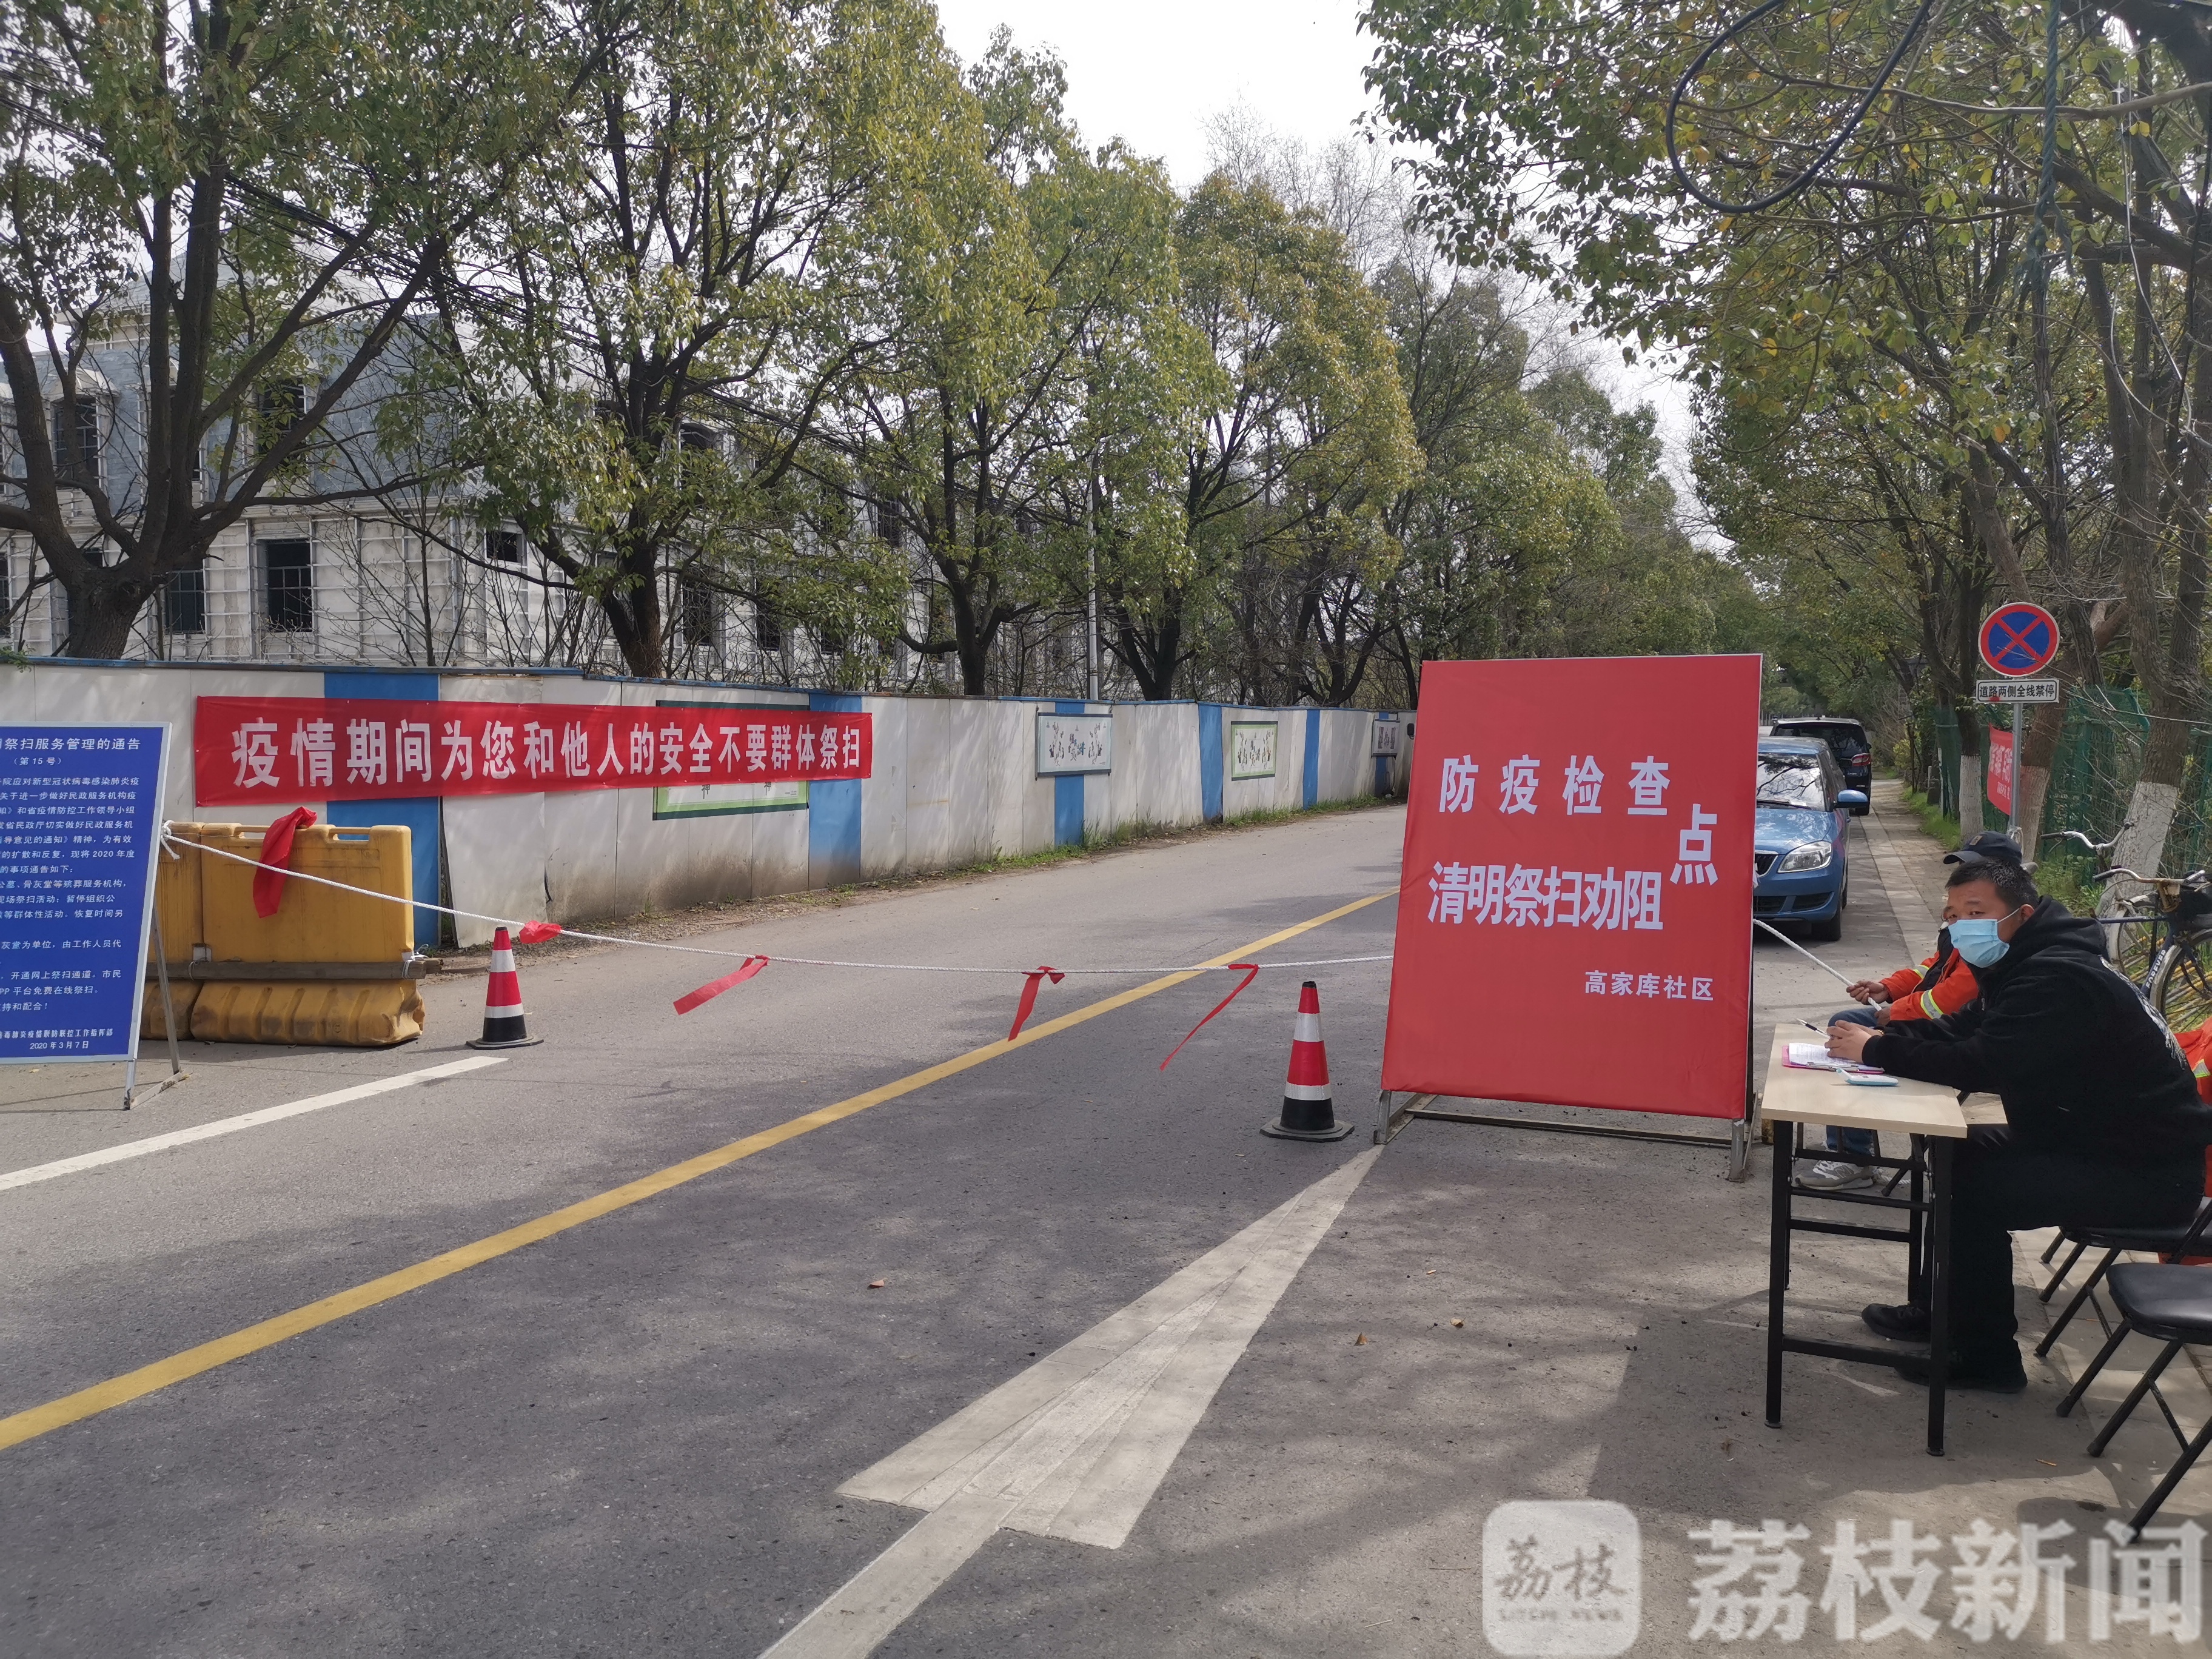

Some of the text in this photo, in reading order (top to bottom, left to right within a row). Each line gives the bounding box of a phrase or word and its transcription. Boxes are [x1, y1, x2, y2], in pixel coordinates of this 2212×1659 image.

[1979, 684, 2054, 697] 道路两侧全线禁停
[0, 737, 141, 750] 祭扫服务管理的通告
[231, 717, 860, 788] 疫情期间为您和他人的安全不要群体祭扫
[0, 777, 140, 786] 院应对新型冠状病毒感染肺炎疫
[1439, 754, 1671, 816] 防疫检查
[0, 834, 132, 844] 导意见的通知》精神，为有效
[0, 865, 73, 874] 的事项通告如下：
[1428, 861, 1663, 930] 清明祭扫劝阻
[2146, 950, 2166, 988] FOREVER
[1585, 970, 1714, 1000] 高家库社区
[0, 1002, 48, 1012] 持和配合！
